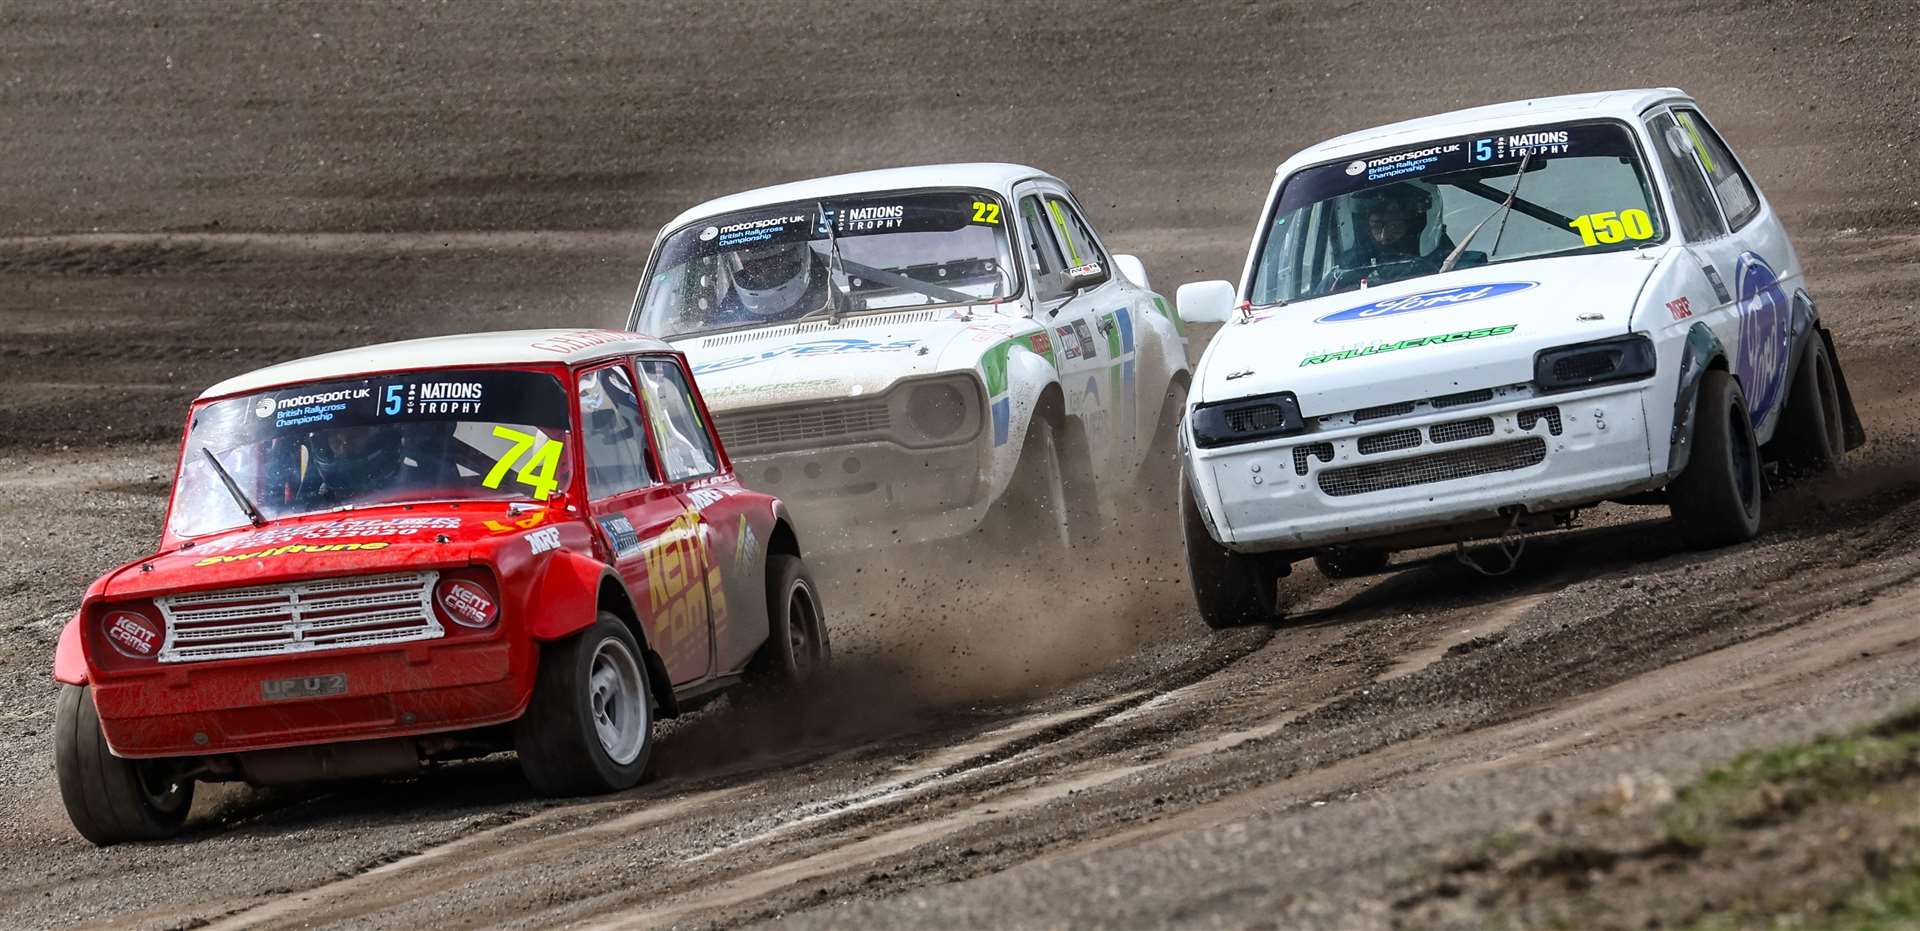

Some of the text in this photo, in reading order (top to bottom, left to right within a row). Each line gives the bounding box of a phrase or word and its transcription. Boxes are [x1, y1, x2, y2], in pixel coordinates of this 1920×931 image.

[1509, 131, 1568, 147] NATIONS
[1368, 143, 1460, 168] motorsport UK
[1476, 139, 1492, 161] 5
[1368, 156, 1438, 175] British Rallycross
[1368, 164, 1426, 181] Championship
[850, 205, 904, 220] NATIONS
[972, 201, 999, 224] 22
[719, 226, 784, 241] British Rallycross
[720, 214, 805, 234] motorsport UK
[849, 219, 903, 231] TROPHY
[1568, 208, 1654, 247] 150
[719, 233, 771, 247] Championship
[1359, 286, 1494, 317] Ford
[1299, 324, 1519, 367] RALLYCROSS
[278, 387, 370, 409] motorsport UK
[384, 385, 404, 416] 5
[420, 382, 483, 399] NATIONS
[276, 402, 346, 420] British Rallycross
[419, 402, 482, 414] TROPHY
[276, 412, 334, 428] Championship
[482, 425, 564, 501] 74
[451, 584, 491, 611] KENT
[445, 594, 487, 623] CAMS
[115, 616, 155, 642] KENT
[110, 626, 151, 654] CAMS
[263, 675, 345, 695] UP U 2
